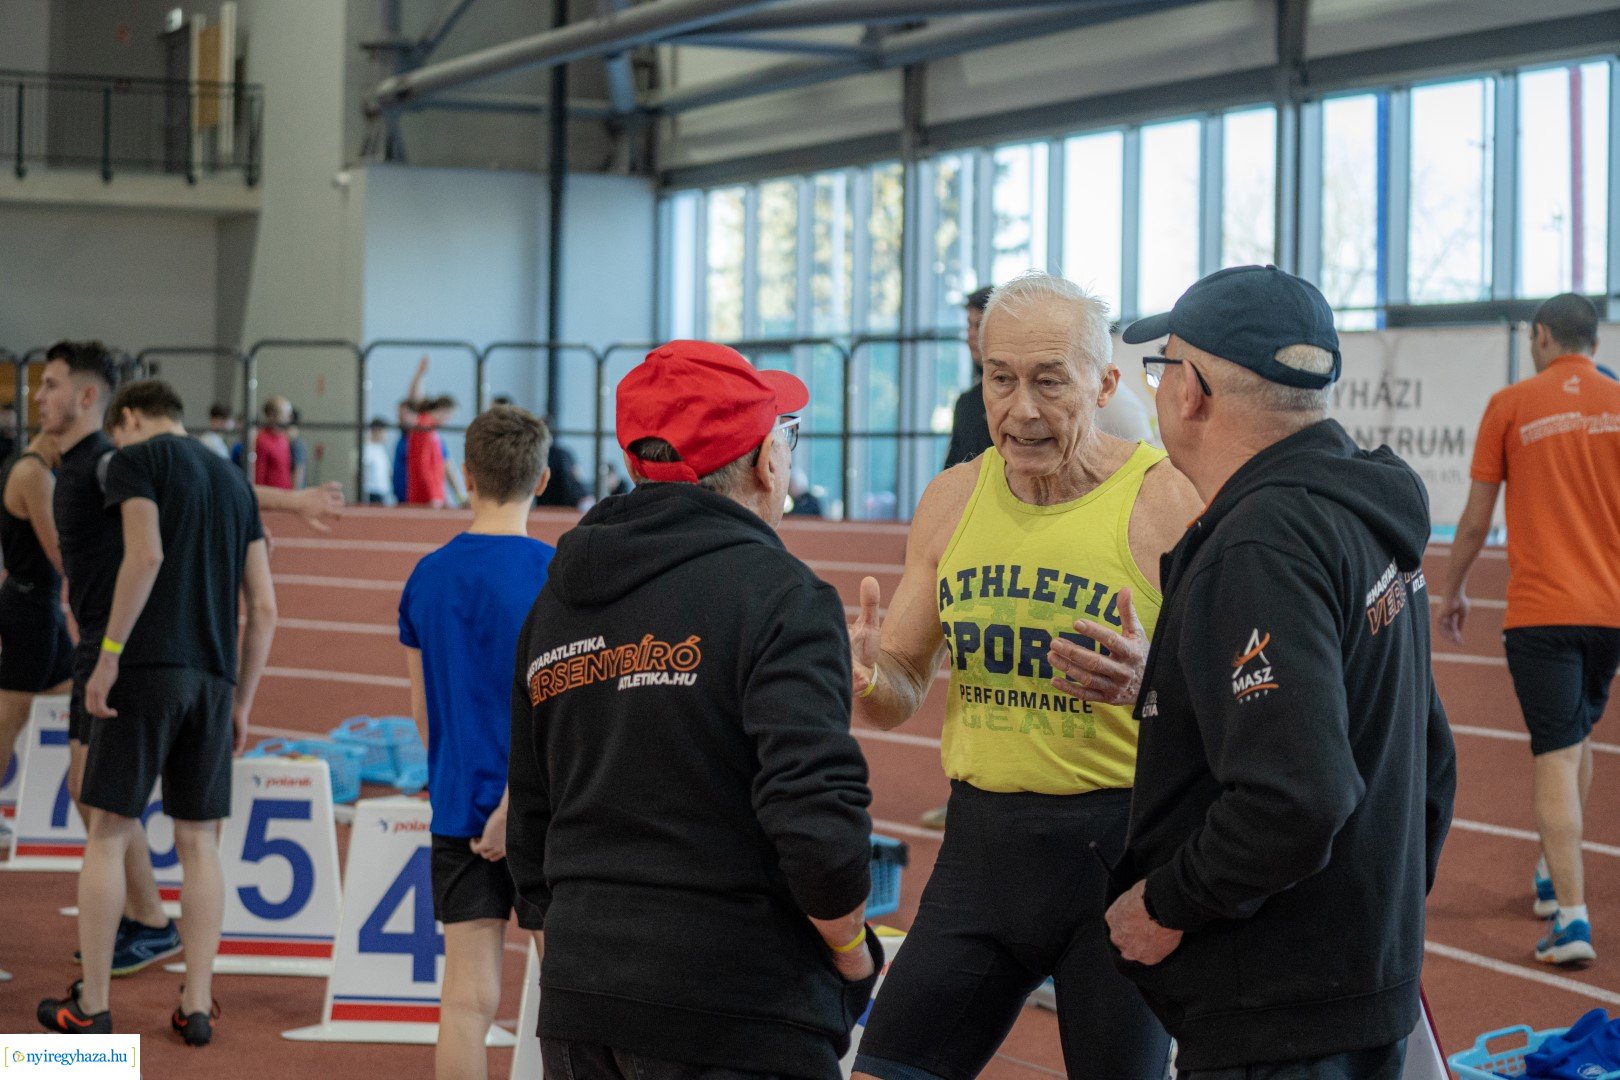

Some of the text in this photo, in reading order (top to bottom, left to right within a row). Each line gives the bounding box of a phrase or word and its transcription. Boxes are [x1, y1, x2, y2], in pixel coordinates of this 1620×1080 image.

[1332, 369, 1422, 408] YHÁZI
[1354, 427, 1465, 457] NTRUM
[939, 564, 1122, 627] ATHLETIC
[530, 634, 702, 707] ERSENYBÍRÓ
[617, 672, 698, 691] ATLETIKA.HU
[1233, 666, 1274, 695] MASZ
[959, 684, 1093, 714] PERFORMANCE
[961, 703, 1097, 739] GEAR
[393, 819, 430, 834] pola
[236, 798, 315, 921] 5
[358, 846, 446, 982] 4
